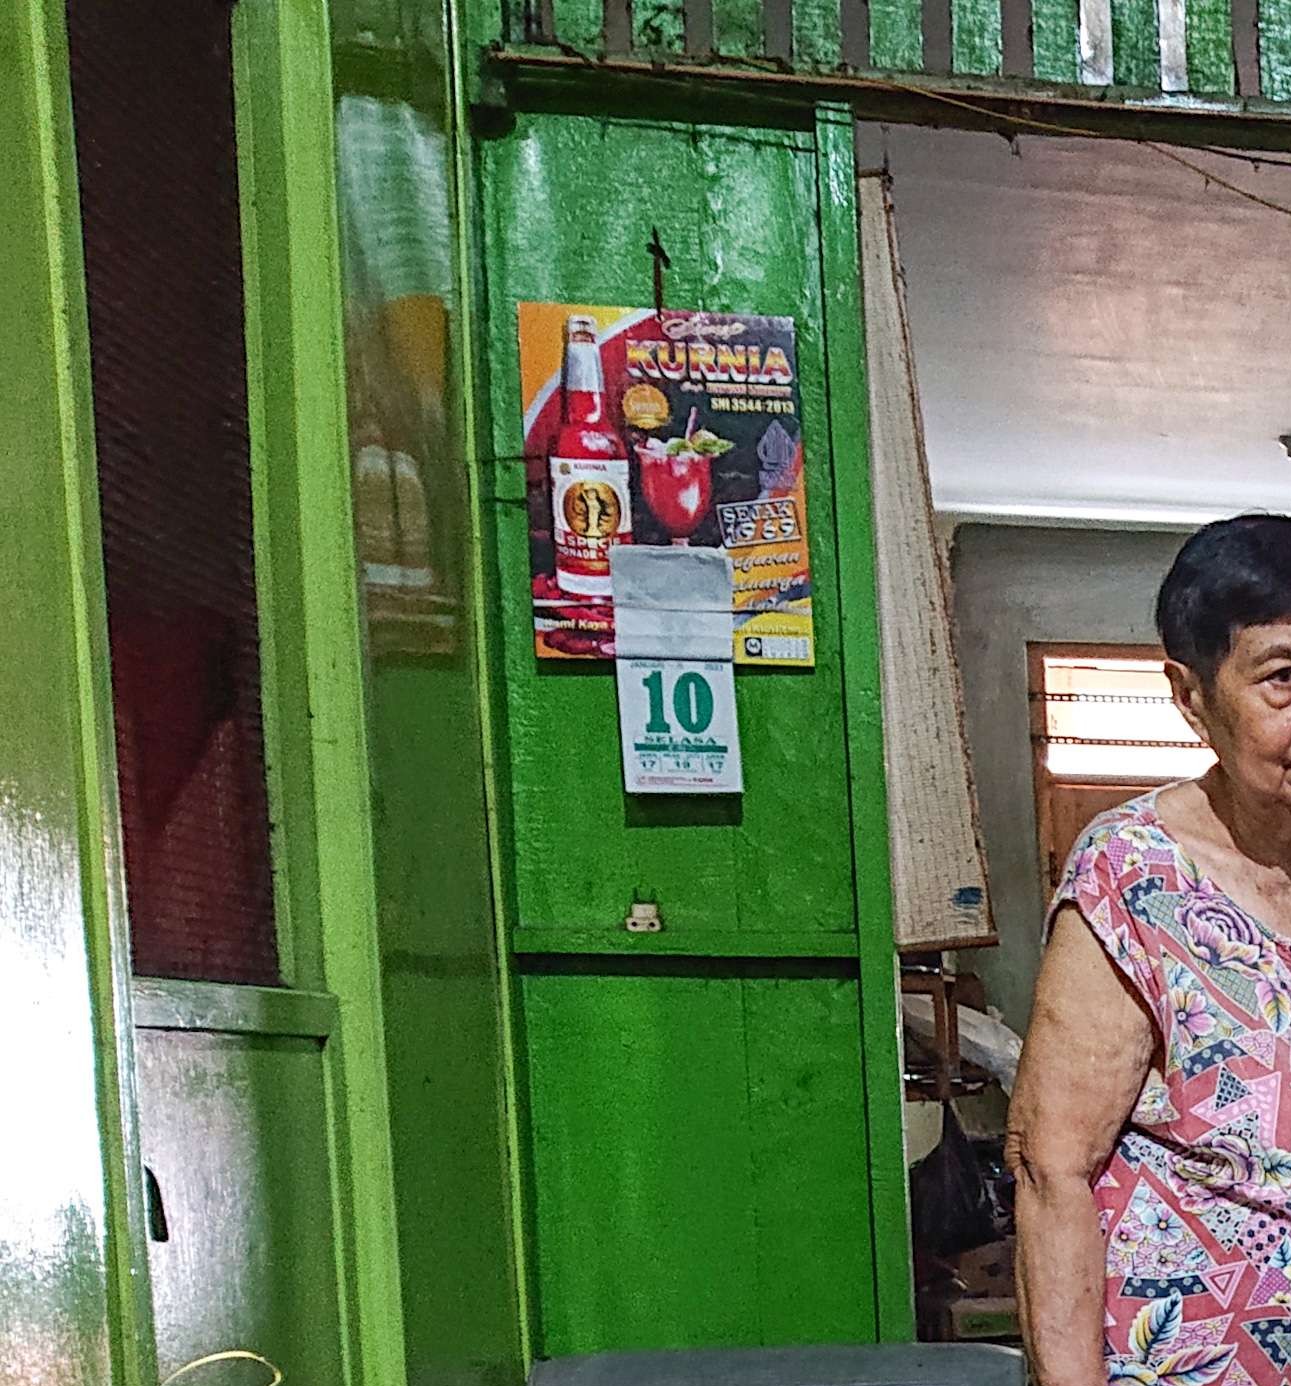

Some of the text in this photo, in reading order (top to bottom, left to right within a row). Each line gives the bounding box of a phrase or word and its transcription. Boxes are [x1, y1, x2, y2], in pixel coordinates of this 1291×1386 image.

[626, 339, 793, 384] KURNIA
[722, 502, 793, 524] SEJAK
[724, 519, 795, 544] 1969
[643, 670, 714, 734] 10
